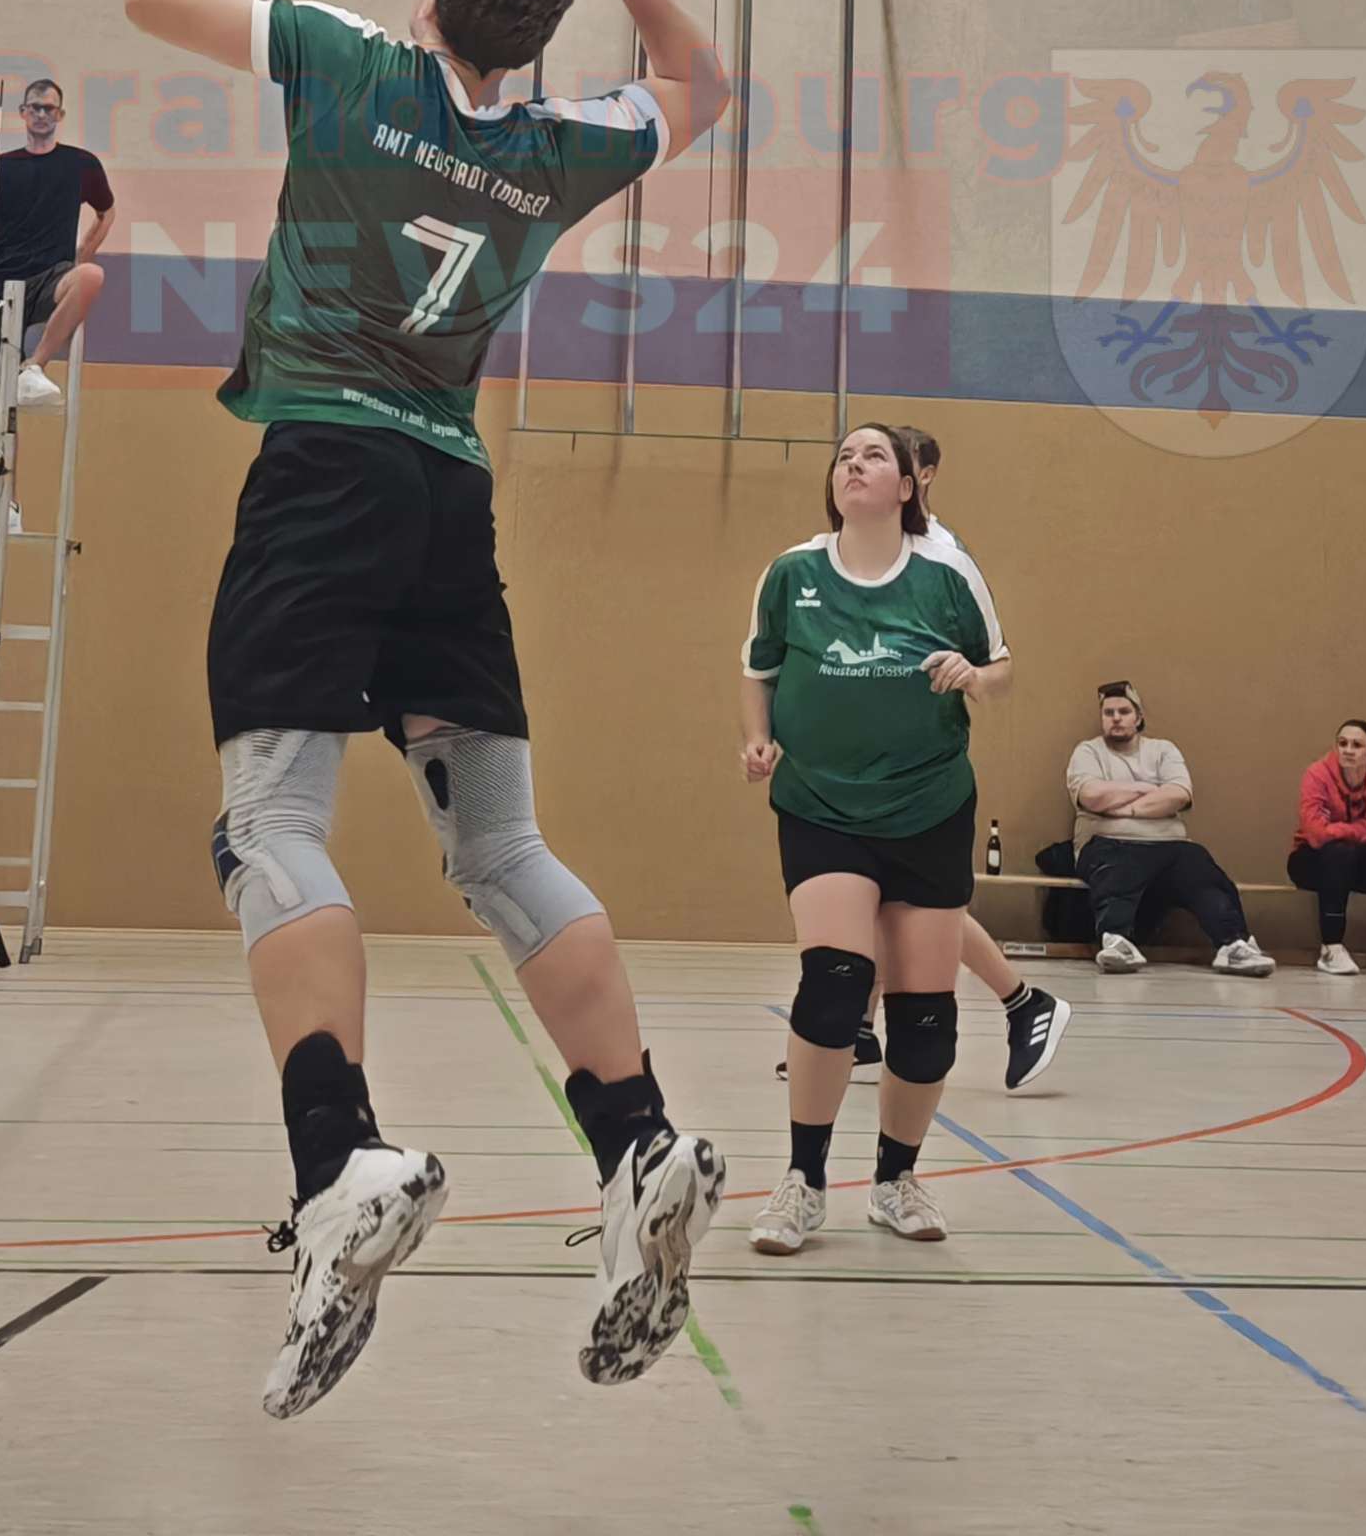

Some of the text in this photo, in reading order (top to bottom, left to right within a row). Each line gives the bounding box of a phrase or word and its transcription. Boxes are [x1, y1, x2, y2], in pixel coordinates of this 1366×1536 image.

[373, 124, 413, 158] AMT
[414, 140, 490, 192] NEUSTADT
[401, 214, 485, 334] 7
[819, 664, 870, 677] Neustadt
